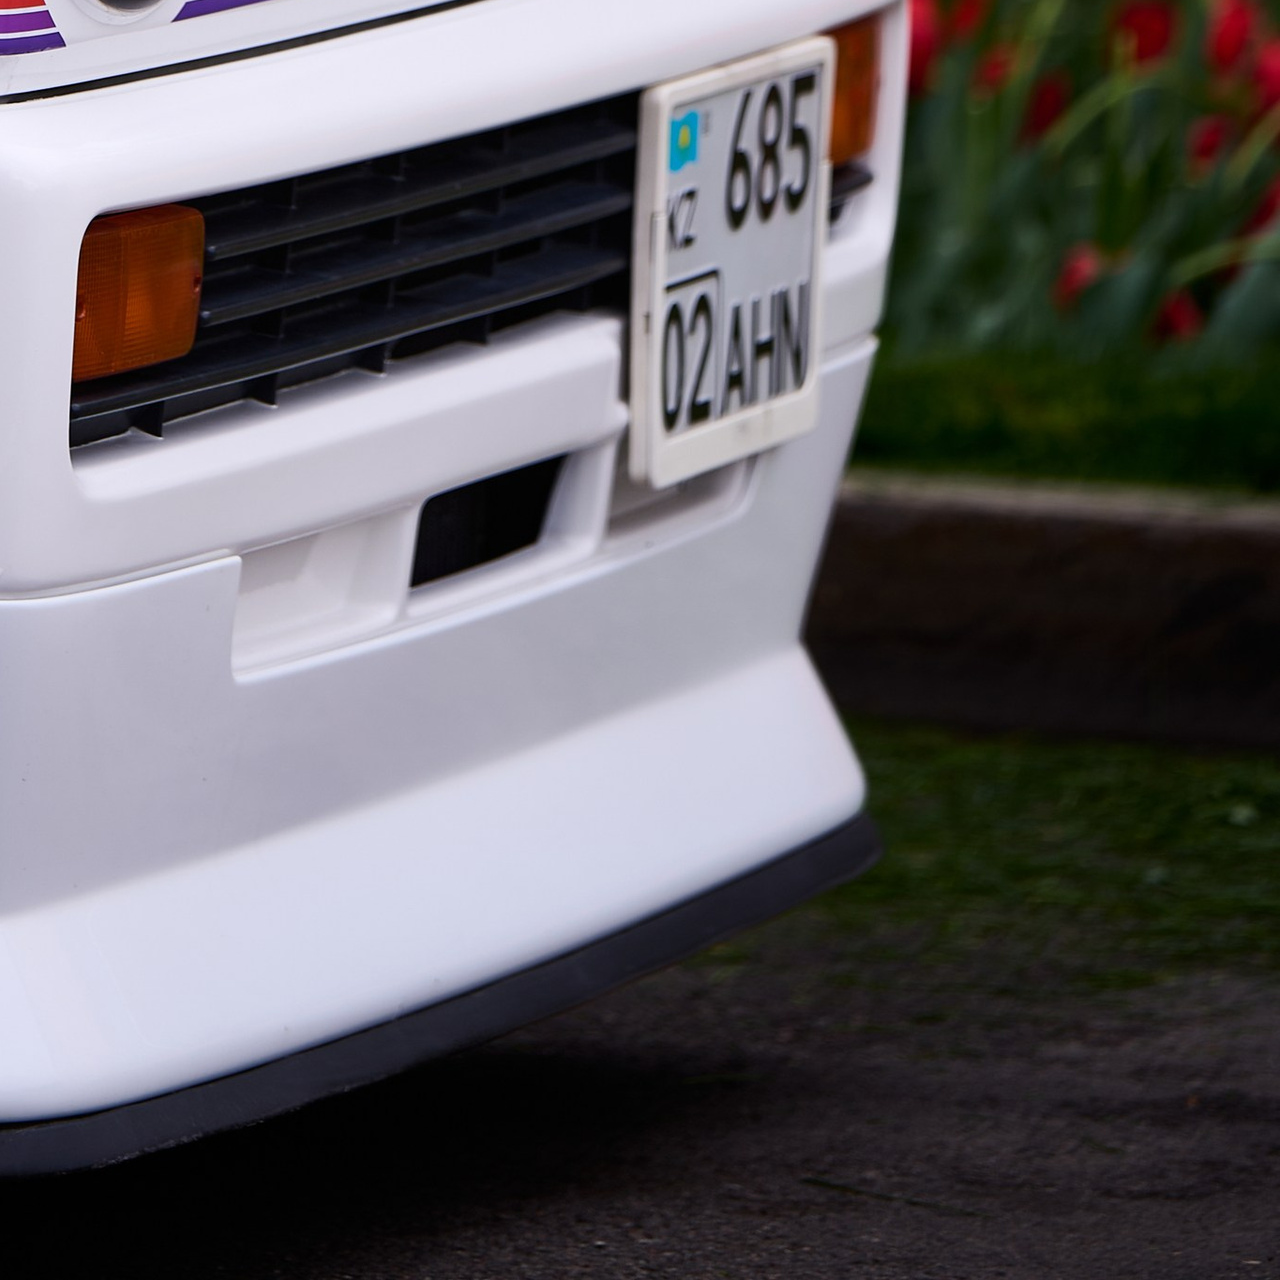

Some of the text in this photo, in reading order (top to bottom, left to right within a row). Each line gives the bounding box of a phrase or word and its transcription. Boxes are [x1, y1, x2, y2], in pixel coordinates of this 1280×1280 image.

[667, 187, 697, 249] KZ
[724, 70, 816, 229] 685
[663, 281, 810, 432] 02 AHN
